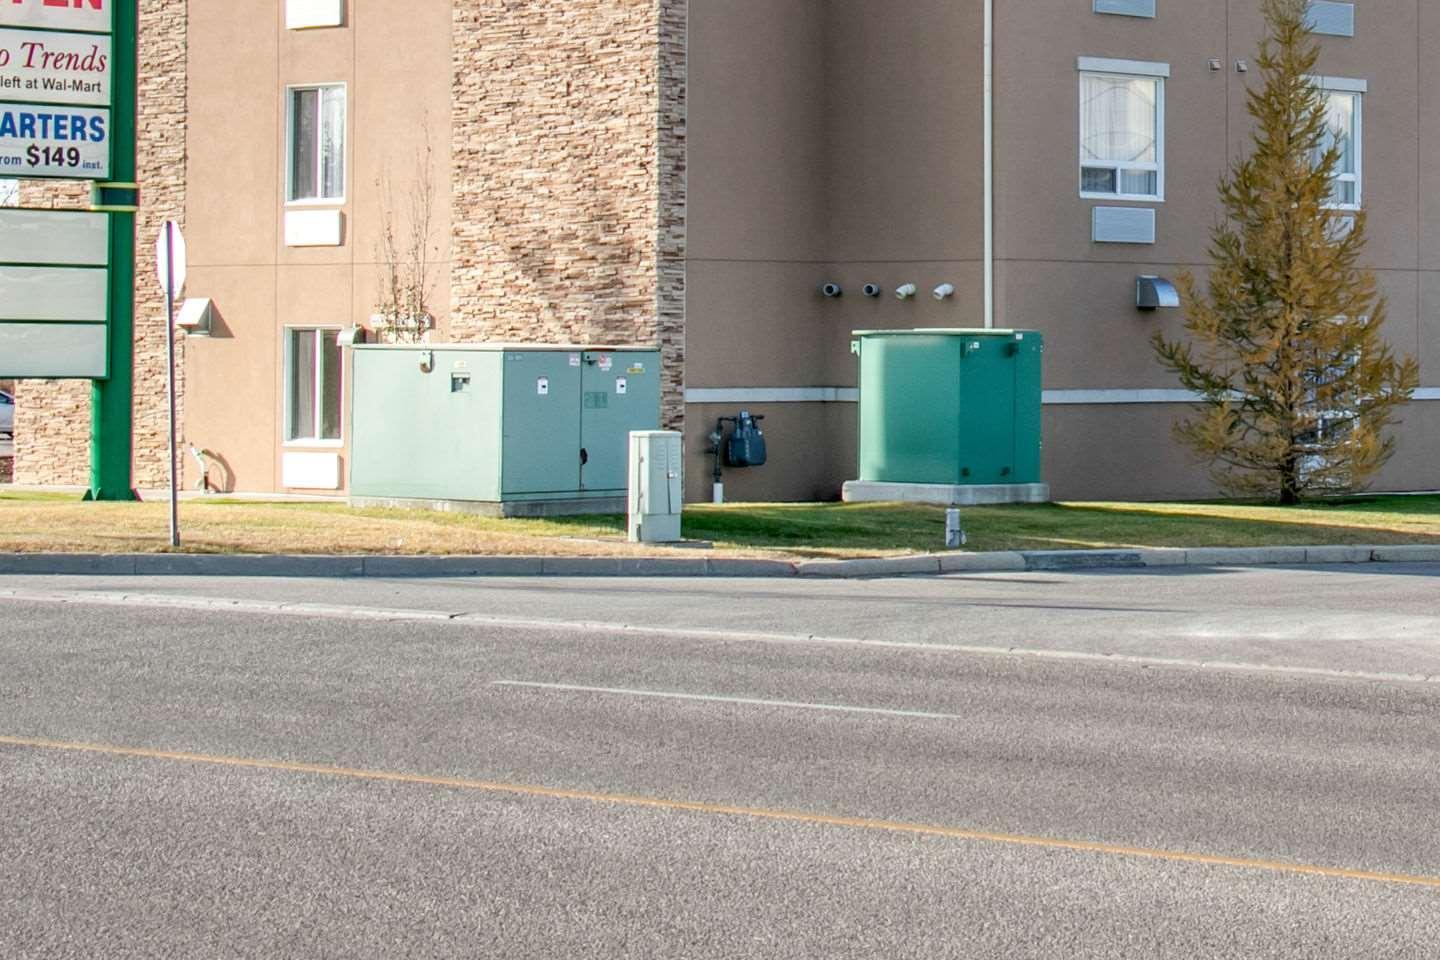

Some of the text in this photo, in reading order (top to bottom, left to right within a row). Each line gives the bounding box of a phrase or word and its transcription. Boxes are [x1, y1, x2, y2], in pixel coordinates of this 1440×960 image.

[20, 42, 107, 72] Trends
[25, 78, 38, 90] at
[42, 77, 102, 93] Wal-Mart
[0, 111, 105, 142] ARTERS
[26, 143, 80, 168] $149
